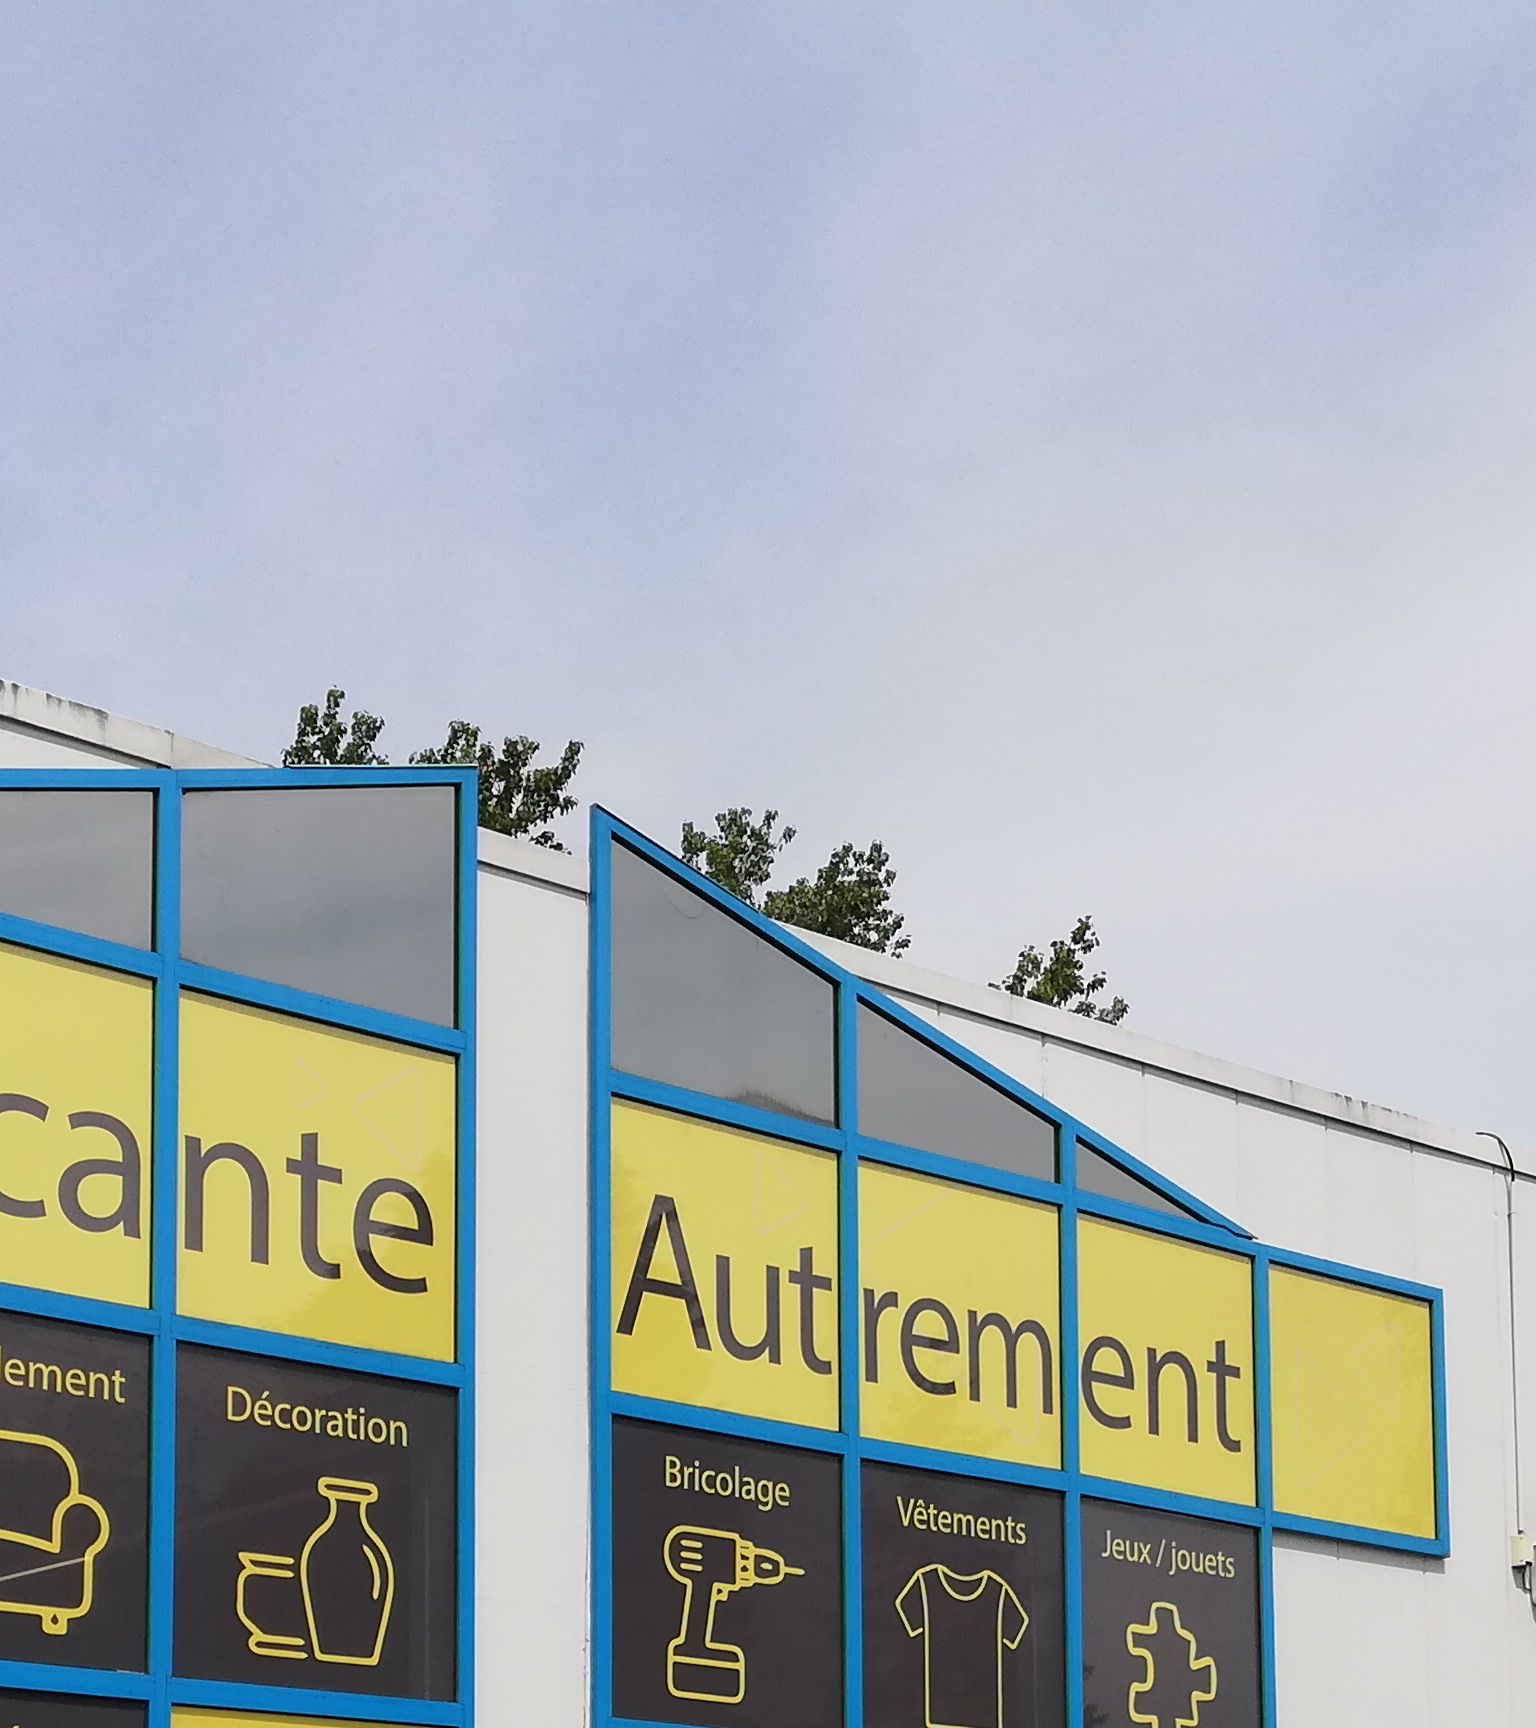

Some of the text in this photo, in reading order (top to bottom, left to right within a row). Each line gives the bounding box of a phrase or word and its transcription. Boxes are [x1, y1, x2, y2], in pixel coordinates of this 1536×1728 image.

[614, 1192, 1243, 1455] Autrement
[227, 1385, 408, 1447] Décoration
[665, 1455, 790, 1512] Bricolage
[896, 1495, 1027, 1545] Vêtements
[1101, 1529, 1152, 1565] Jeux
[1168, 1540, 1235, 1578] jouets
